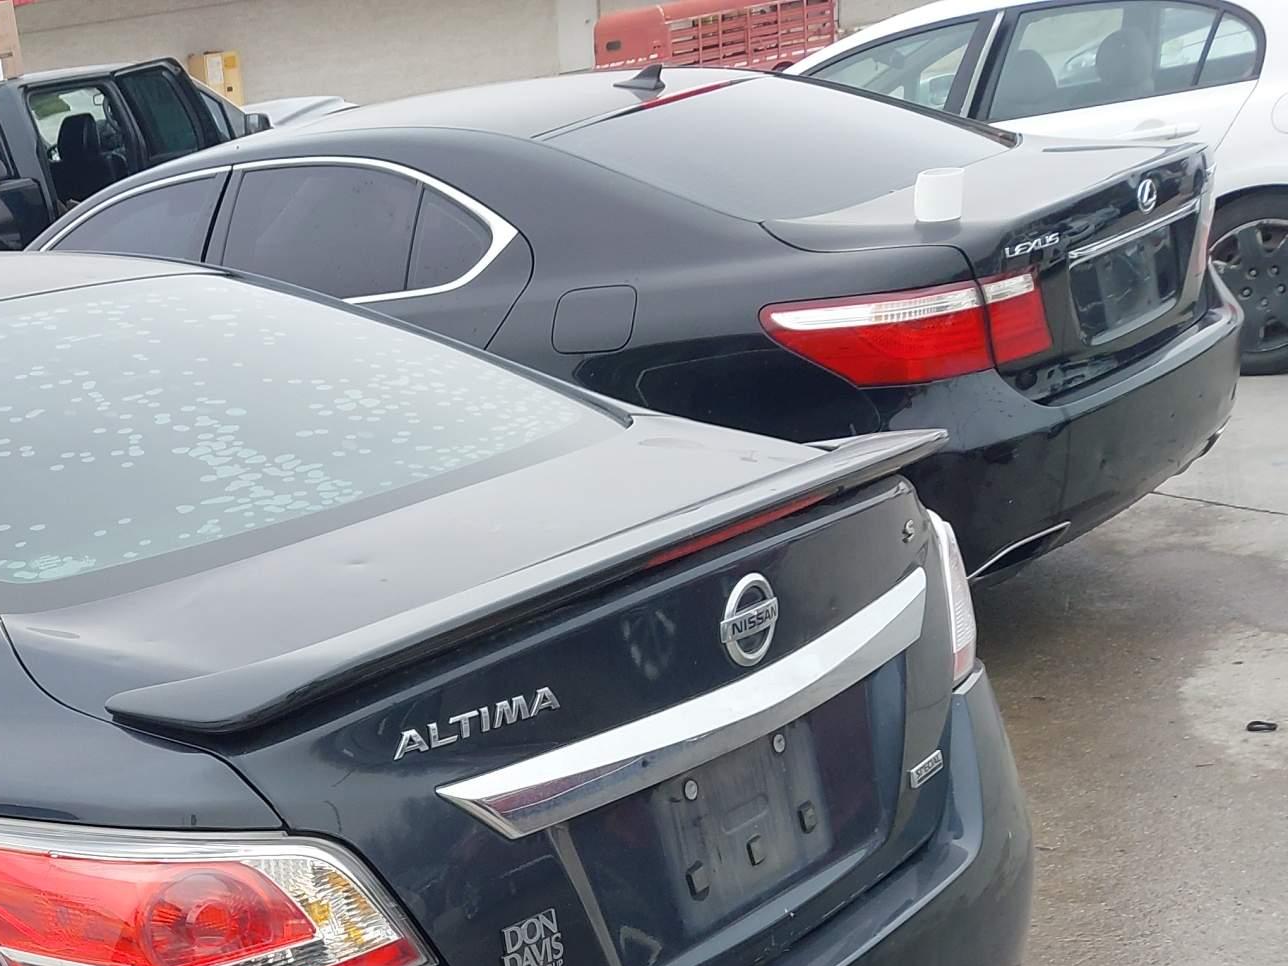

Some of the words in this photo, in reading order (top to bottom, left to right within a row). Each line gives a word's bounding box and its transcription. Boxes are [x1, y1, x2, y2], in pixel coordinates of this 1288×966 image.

[1004, 232, 1060, 258] LEXUS
[732, 605, 777, 635] NISSAN
[393, 686, 561, 761] ALTIMA
[501, 908, 559, 953] DON
